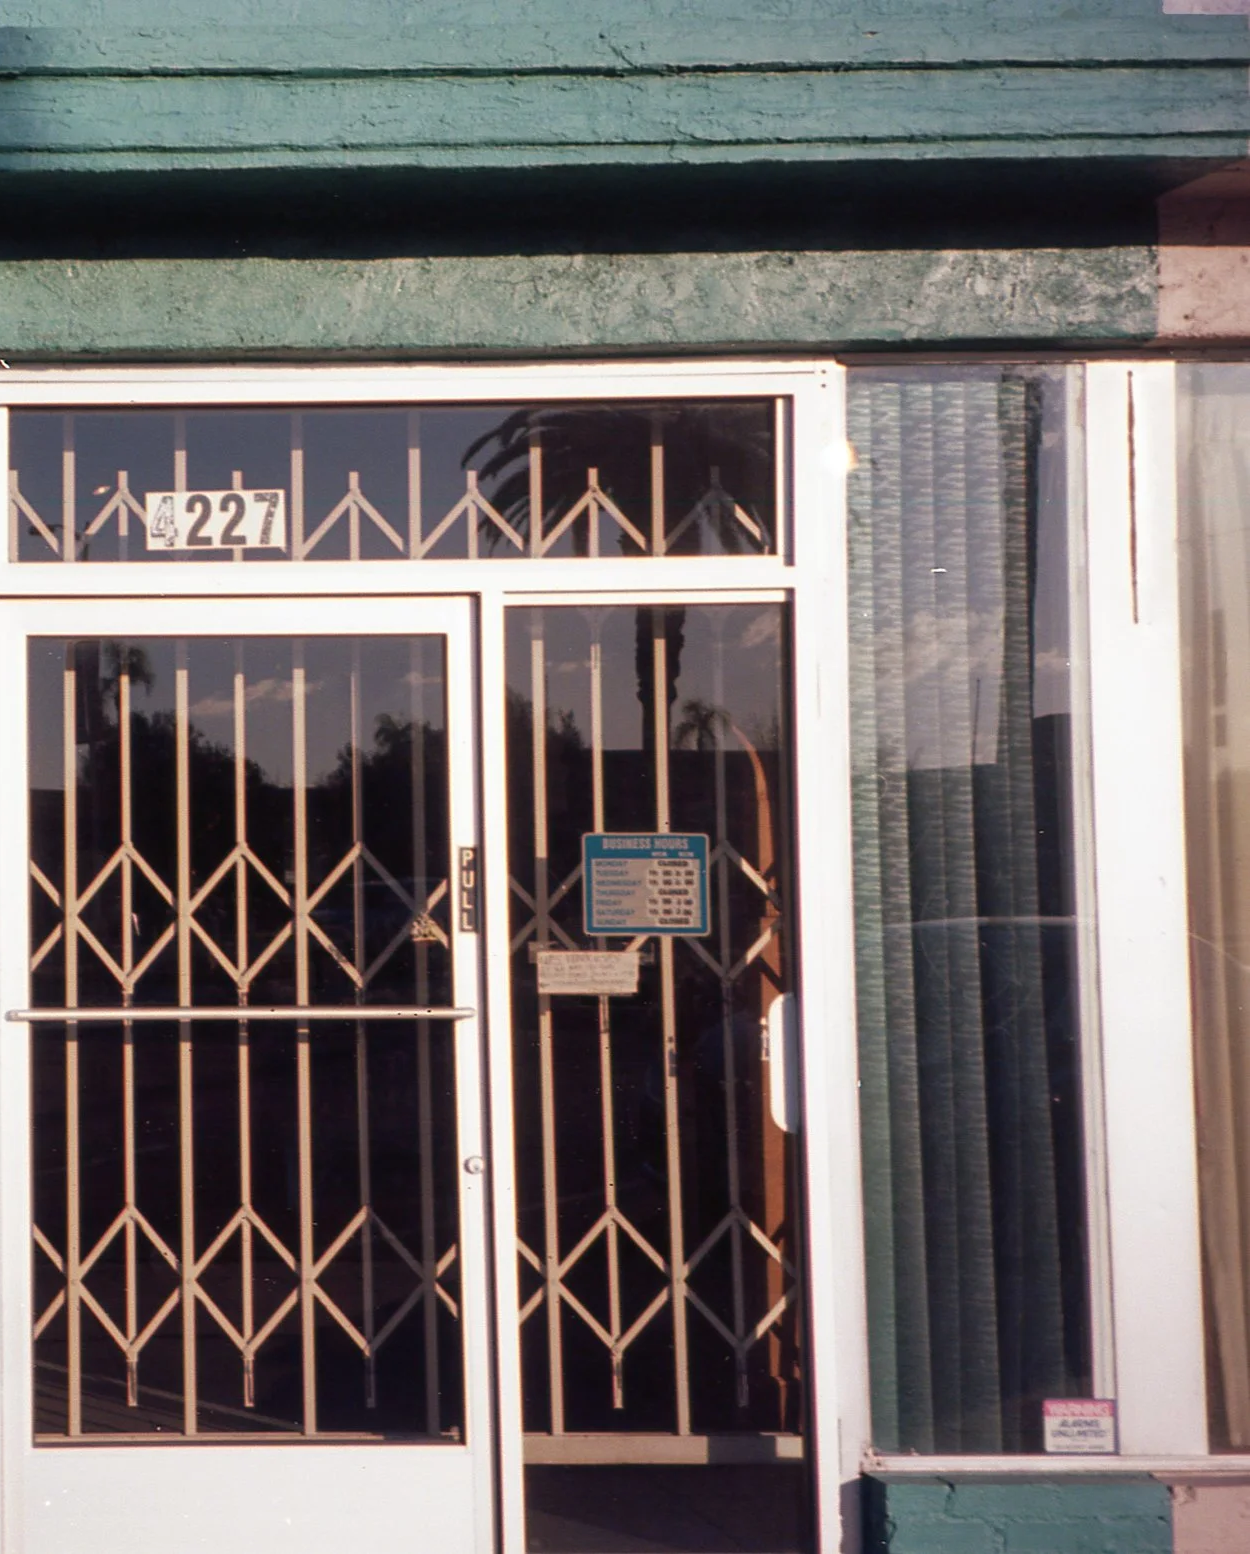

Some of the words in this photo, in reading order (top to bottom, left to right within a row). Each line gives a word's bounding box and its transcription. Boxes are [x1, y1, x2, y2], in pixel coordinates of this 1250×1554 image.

[151, 492, 279, 547] 4227
[602, 838, 651, 849] BUSINESS
[654, 838, 689, 849] HOURS
[462, 850, 475, 930] PULL
[596, 908, 635, 916] SATURDAY
[1050, 1403, 1110, 1415] WARNING
